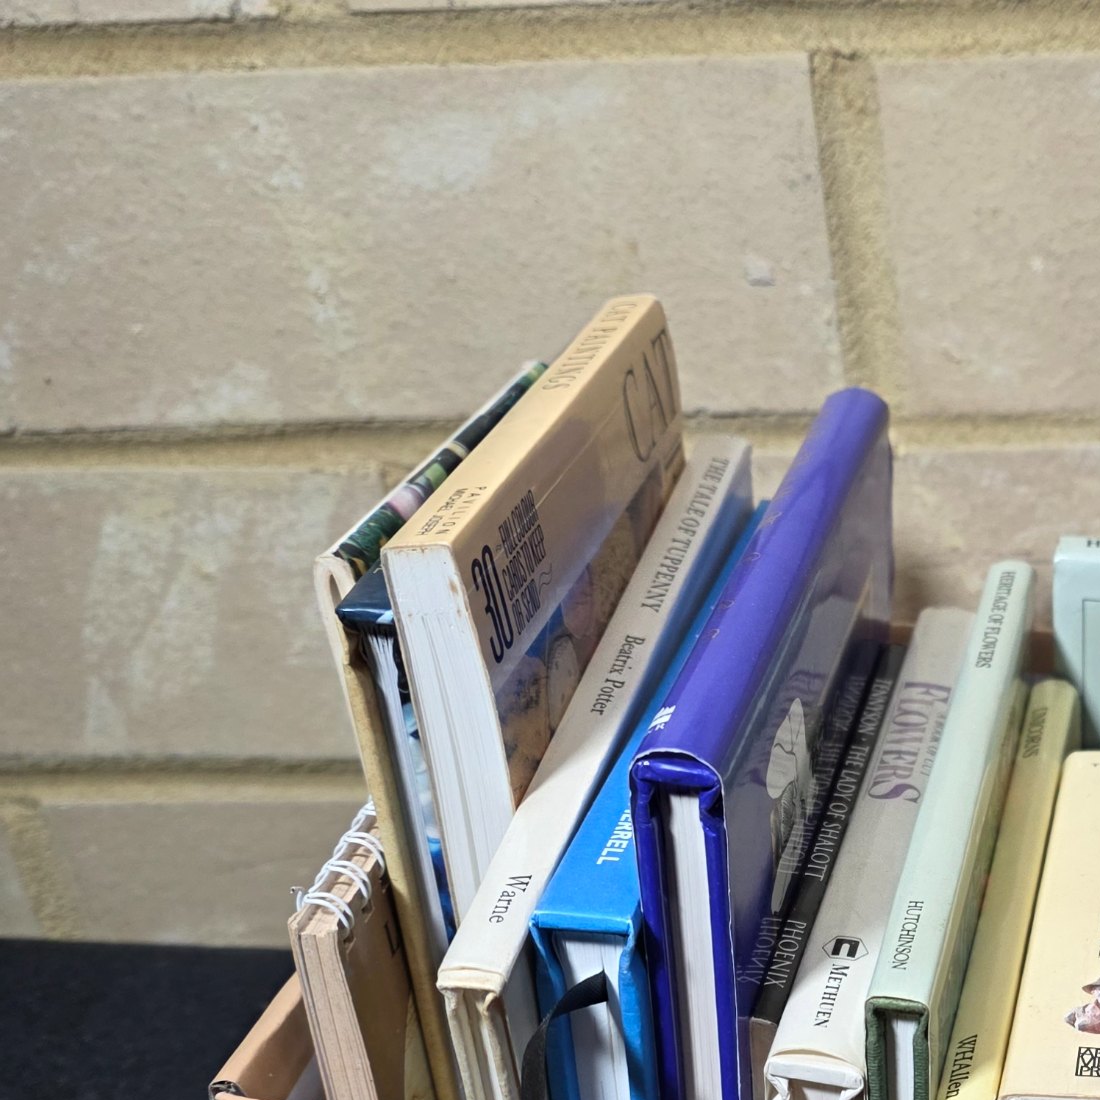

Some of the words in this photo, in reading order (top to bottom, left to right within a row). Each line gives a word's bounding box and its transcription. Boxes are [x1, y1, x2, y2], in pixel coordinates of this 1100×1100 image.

[623, 328, 679, 462] CAT
[704, 456, 730, 483] THE
[435, 485, 487, 535] PAVILION
[689, 483, 718, 520] TALE
[531, 523, 547, 570] KEEP
[676, 517, 701, 541] OF
[641, 537, 691, 614] TUPPENNY
[991, 571, 1016, 613] HERITAGE
[471, 544, 514, 664] 30
[987, 613, 1005, 625] OF
[609, 633, 646, 676] Beatrix
[975, 626, 1001, 669] FLOWERS
[590, 676, 626, 717] Potter
[857, 679, 893, 736] TENNYSON
[845, 745, 871, 768] THE
[868, 681, 953, 805] FLOWERS
[833, 767, 862, 802] LADY
[827, 801, 850, 821] OF
[596, 809, 634, 865] ERRELL
[804, 820, 842, 882] SHALOTT
[489, 873, 533, 924] Warne
[763, 919, 808, 989] PHOENIX
[891, 900, 925, 970] HUTCHINSON
[814, 963, 850, 1028] METHUEN
